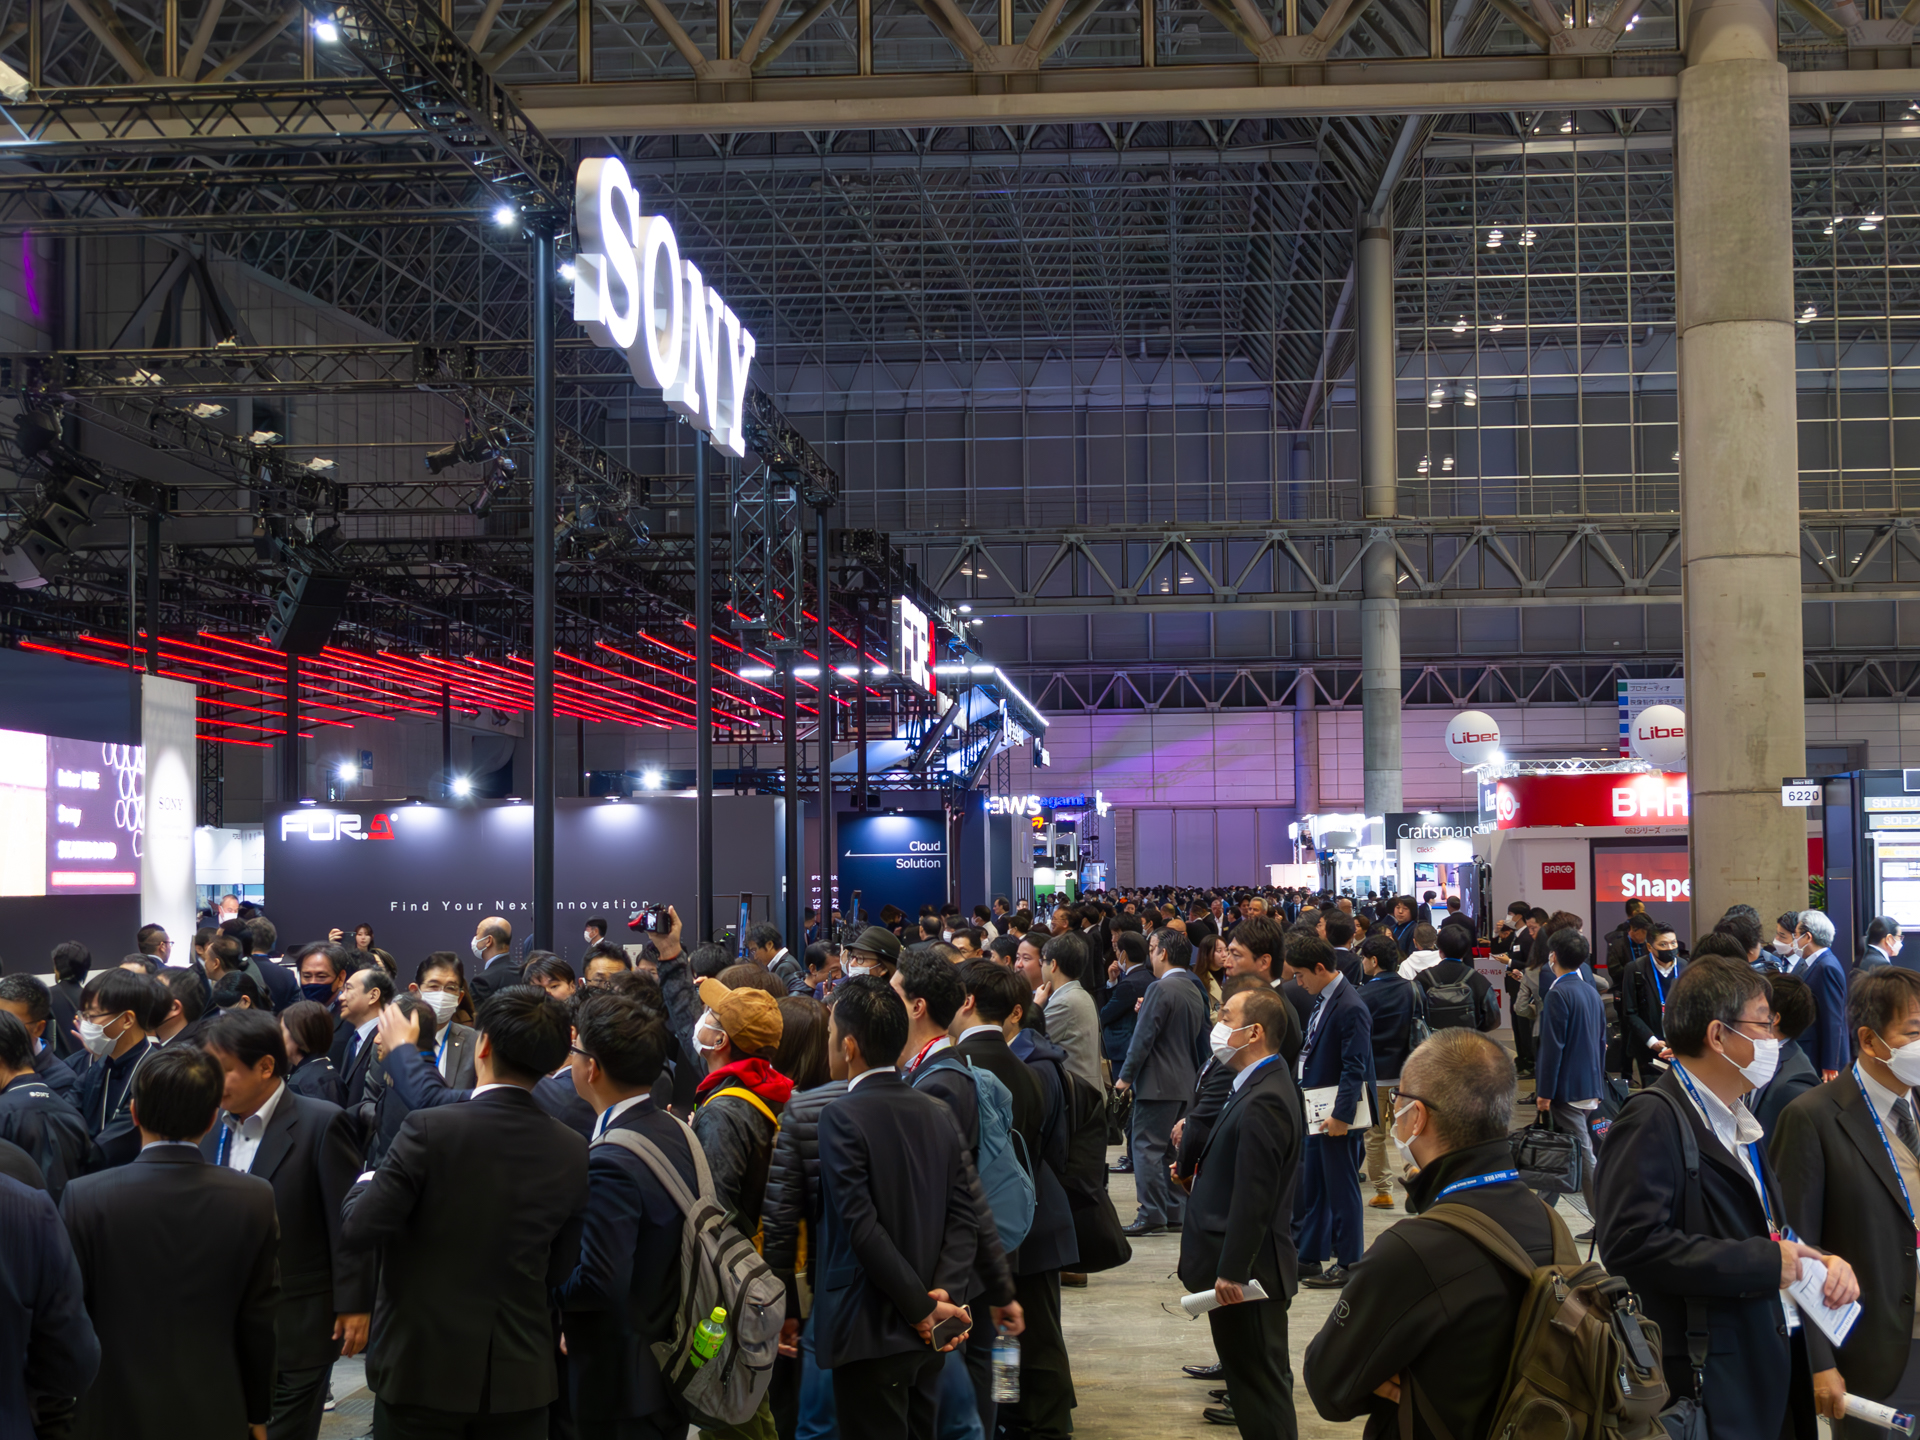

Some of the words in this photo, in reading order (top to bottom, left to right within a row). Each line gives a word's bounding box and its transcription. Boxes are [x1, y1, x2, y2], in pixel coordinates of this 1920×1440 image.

[575, 156, 756, 458] SONY
[1452, 732, 1499, 744] Libec
[1638, 726, 1685, 741] Libe
[1033, 793, 1085, 809] egami
[1612, 787, 1689, 817] BAR
[1788, 790, 1820, 802] 6220
[1871, 797, 1920, 809] SDIマトリ
[158, 796, 184, 811] SONY
[988, 795, 1042, 816] aws
[1397, 822, 1482, 839] Craftsmans
[908, 840, 941, 852] Cloud
[895, 858, 941, 869] Solution
[1544, 866, 1573, 874] BARCO
[390, 901, 430, 912] Find
[442, 901, 484, 911] Your
[495, 901, 534, 911] Nex
[556, 899, 650, 910] nnovation
